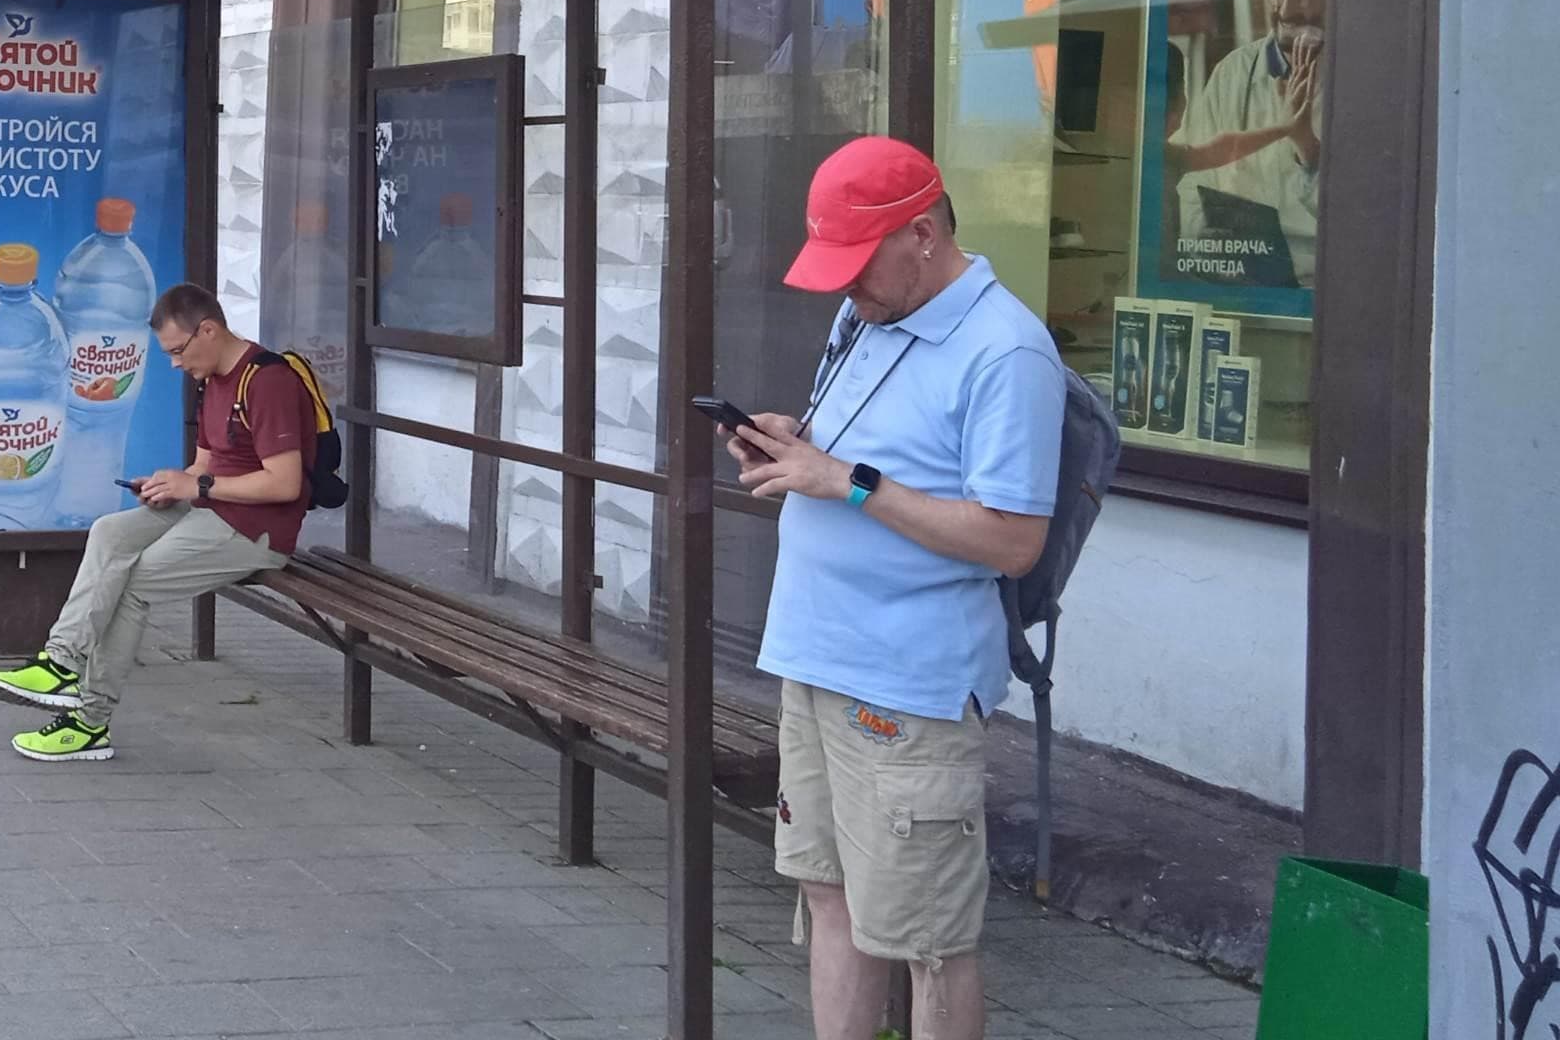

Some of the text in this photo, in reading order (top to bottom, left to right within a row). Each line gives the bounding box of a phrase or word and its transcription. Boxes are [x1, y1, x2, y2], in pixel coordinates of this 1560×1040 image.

[1177, 238, 1274, 255] ПРИЕМ ВРАЧА-
[1177, 258, 1246, 277] ОРТОПЕДА
